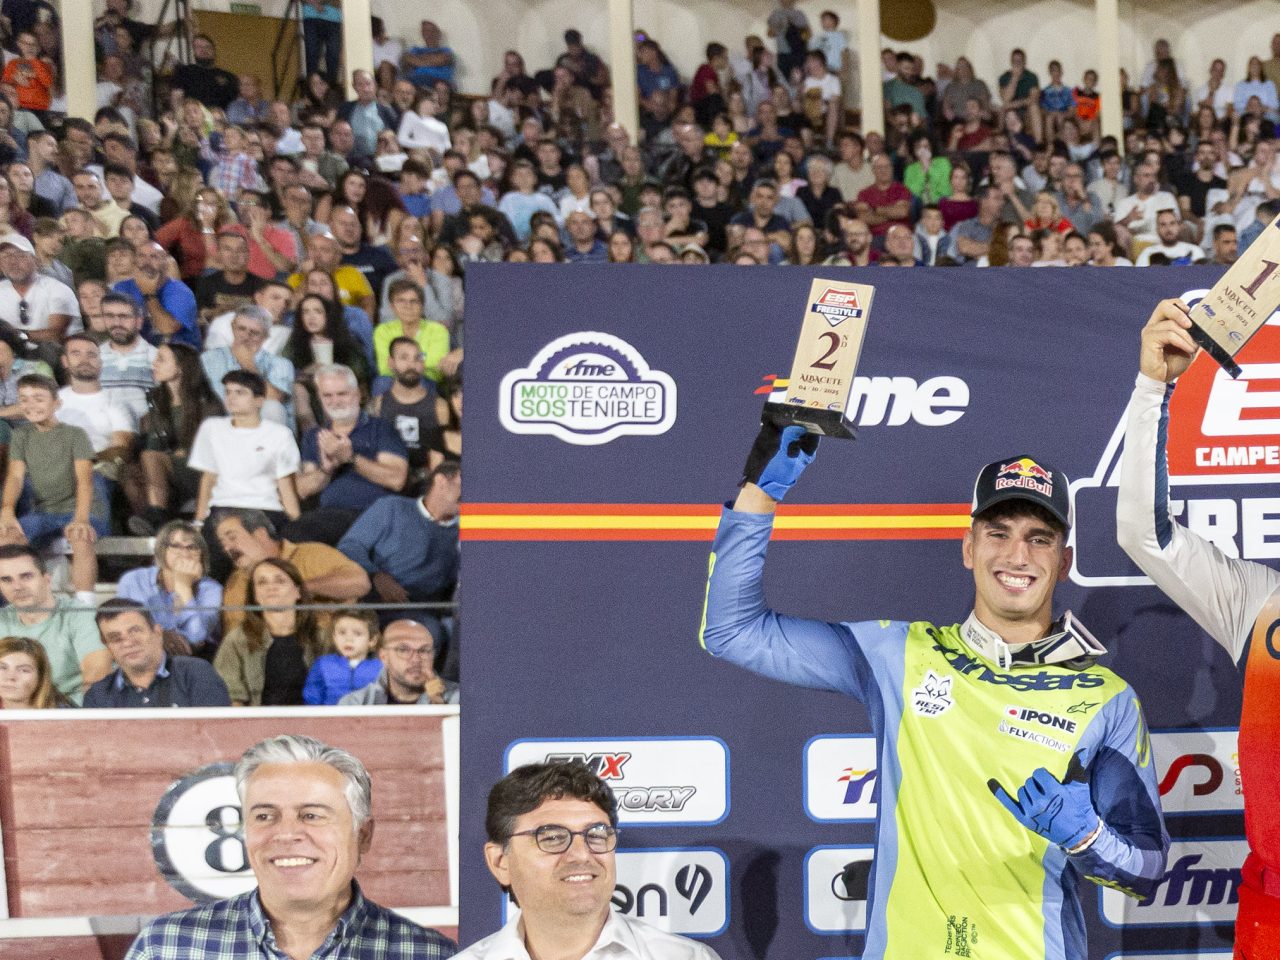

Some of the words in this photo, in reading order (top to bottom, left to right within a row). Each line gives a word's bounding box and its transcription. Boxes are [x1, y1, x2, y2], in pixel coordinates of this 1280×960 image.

[1240, 259, 1280, 301] 1
[824, 292, 856, 304] ESP
[1222, 286, 1258, 320] ALBACETE
[816, 304, 858, 317] FREESTYLE
[810, 331, 841, 372] 2
[564, 360, 616, 377] rfme
[799, 373, 844, 386] ALBACETE
[521, 385, 568, 400] MOTO
[573, 385, 594, 400] DE
[597, 385, 657, 400] CAMPO
[520, 399, 657, 419] SOSTENIBLE
[1020, 708, 1077, 734] IPONE
